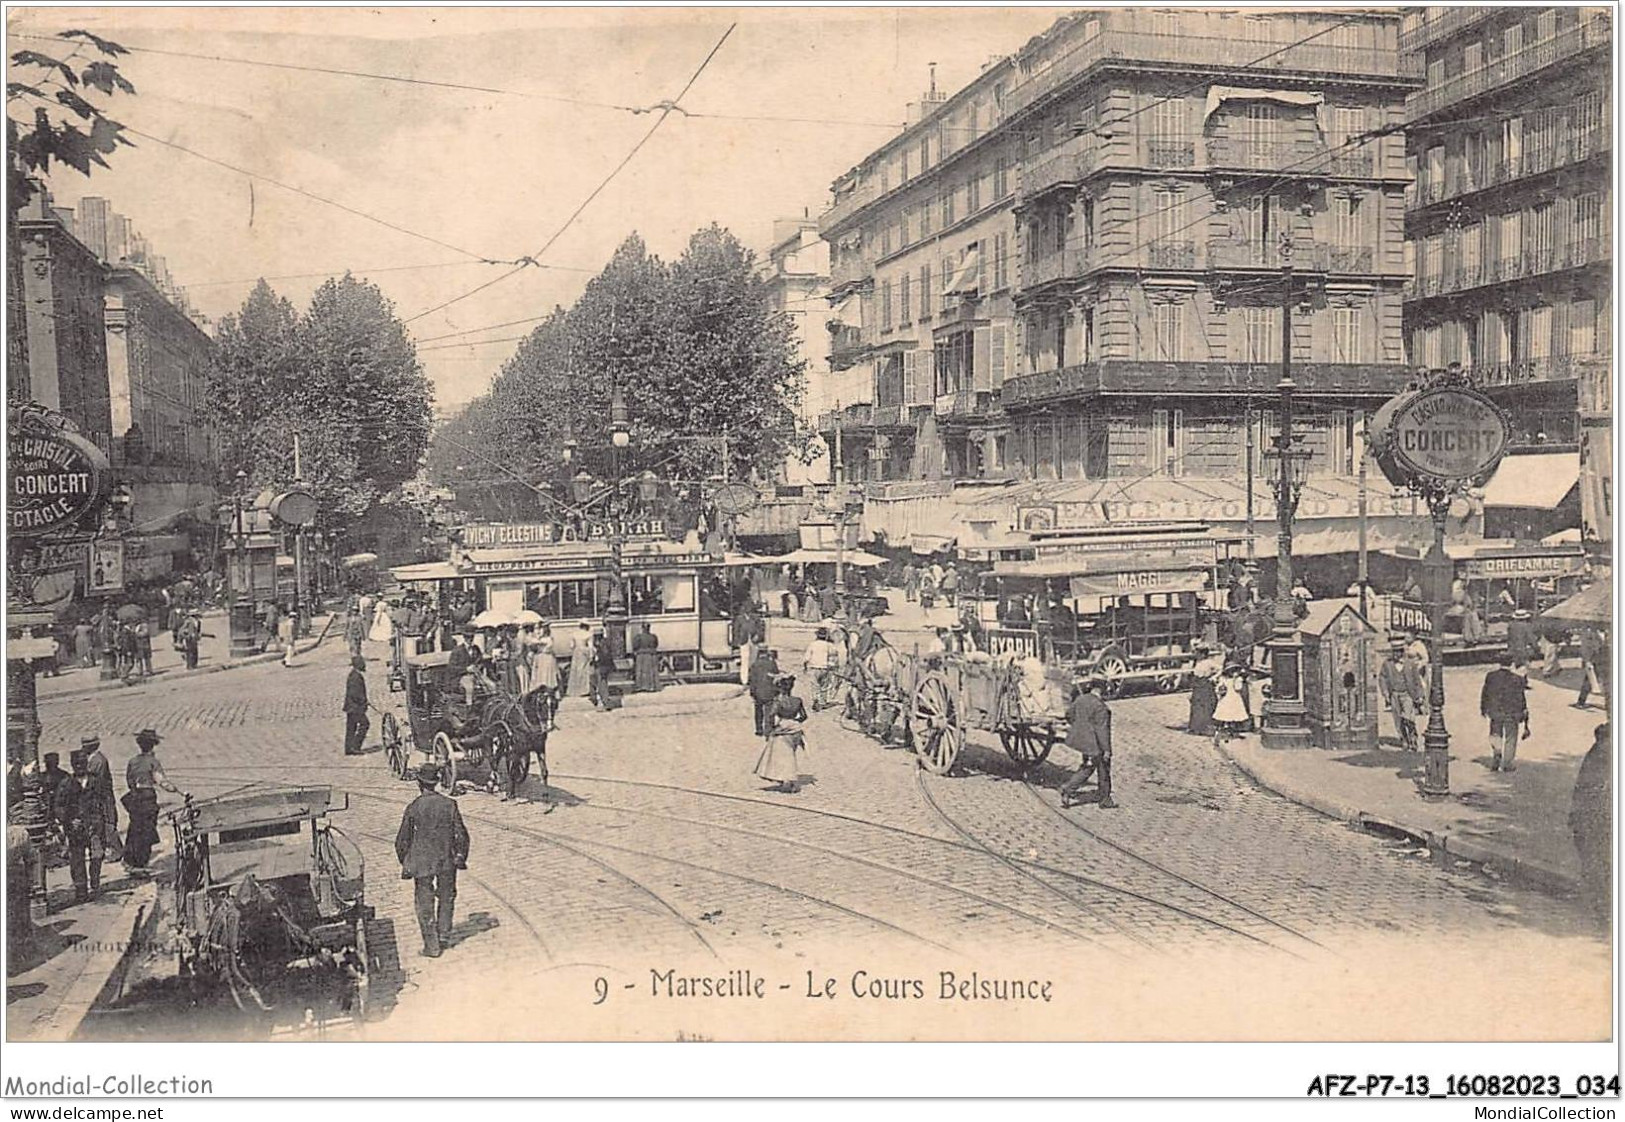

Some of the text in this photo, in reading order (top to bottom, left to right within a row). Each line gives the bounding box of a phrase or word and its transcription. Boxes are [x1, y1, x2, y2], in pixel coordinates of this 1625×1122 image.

[1162, 363, 1373, 387] DENTSTE
[1404, 429, 1495, 452] CONCERT
[24, 439, 77, 470] CRISTAL
[15, 473, 89, 495] CONCERT
[468, 524, 496, 543] VICHY
[1485, 558, 1560, 572] ORIFLAMME
[1117, 572, 1161, 590] MAGGI
